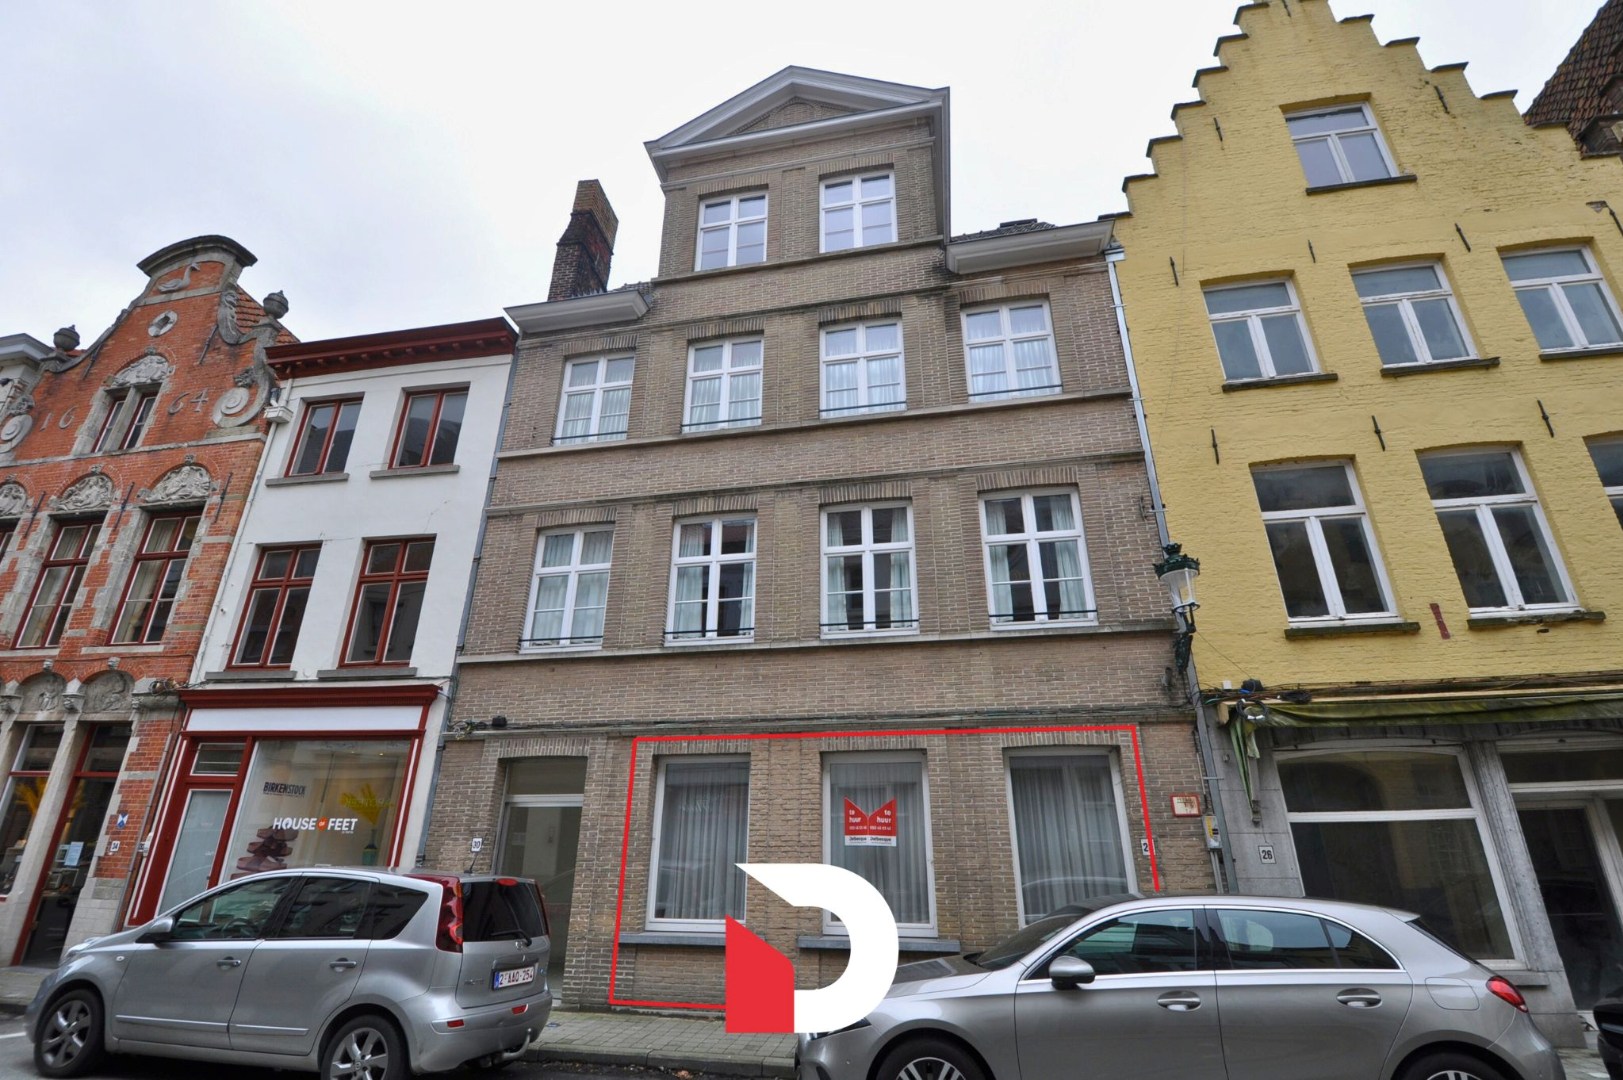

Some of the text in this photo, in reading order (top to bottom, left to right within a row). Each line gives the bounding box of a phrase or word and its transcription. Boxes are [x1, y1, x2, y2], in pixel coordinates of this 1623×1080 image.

[263, 782, 306, 796] BIRKENSTOCK
[272, 817, 317, 830] HOUSE
[327, 818, 358, 831] FEET
[473, 840, 481, 849] 30
[1261, 849, 1273, 860] 26
